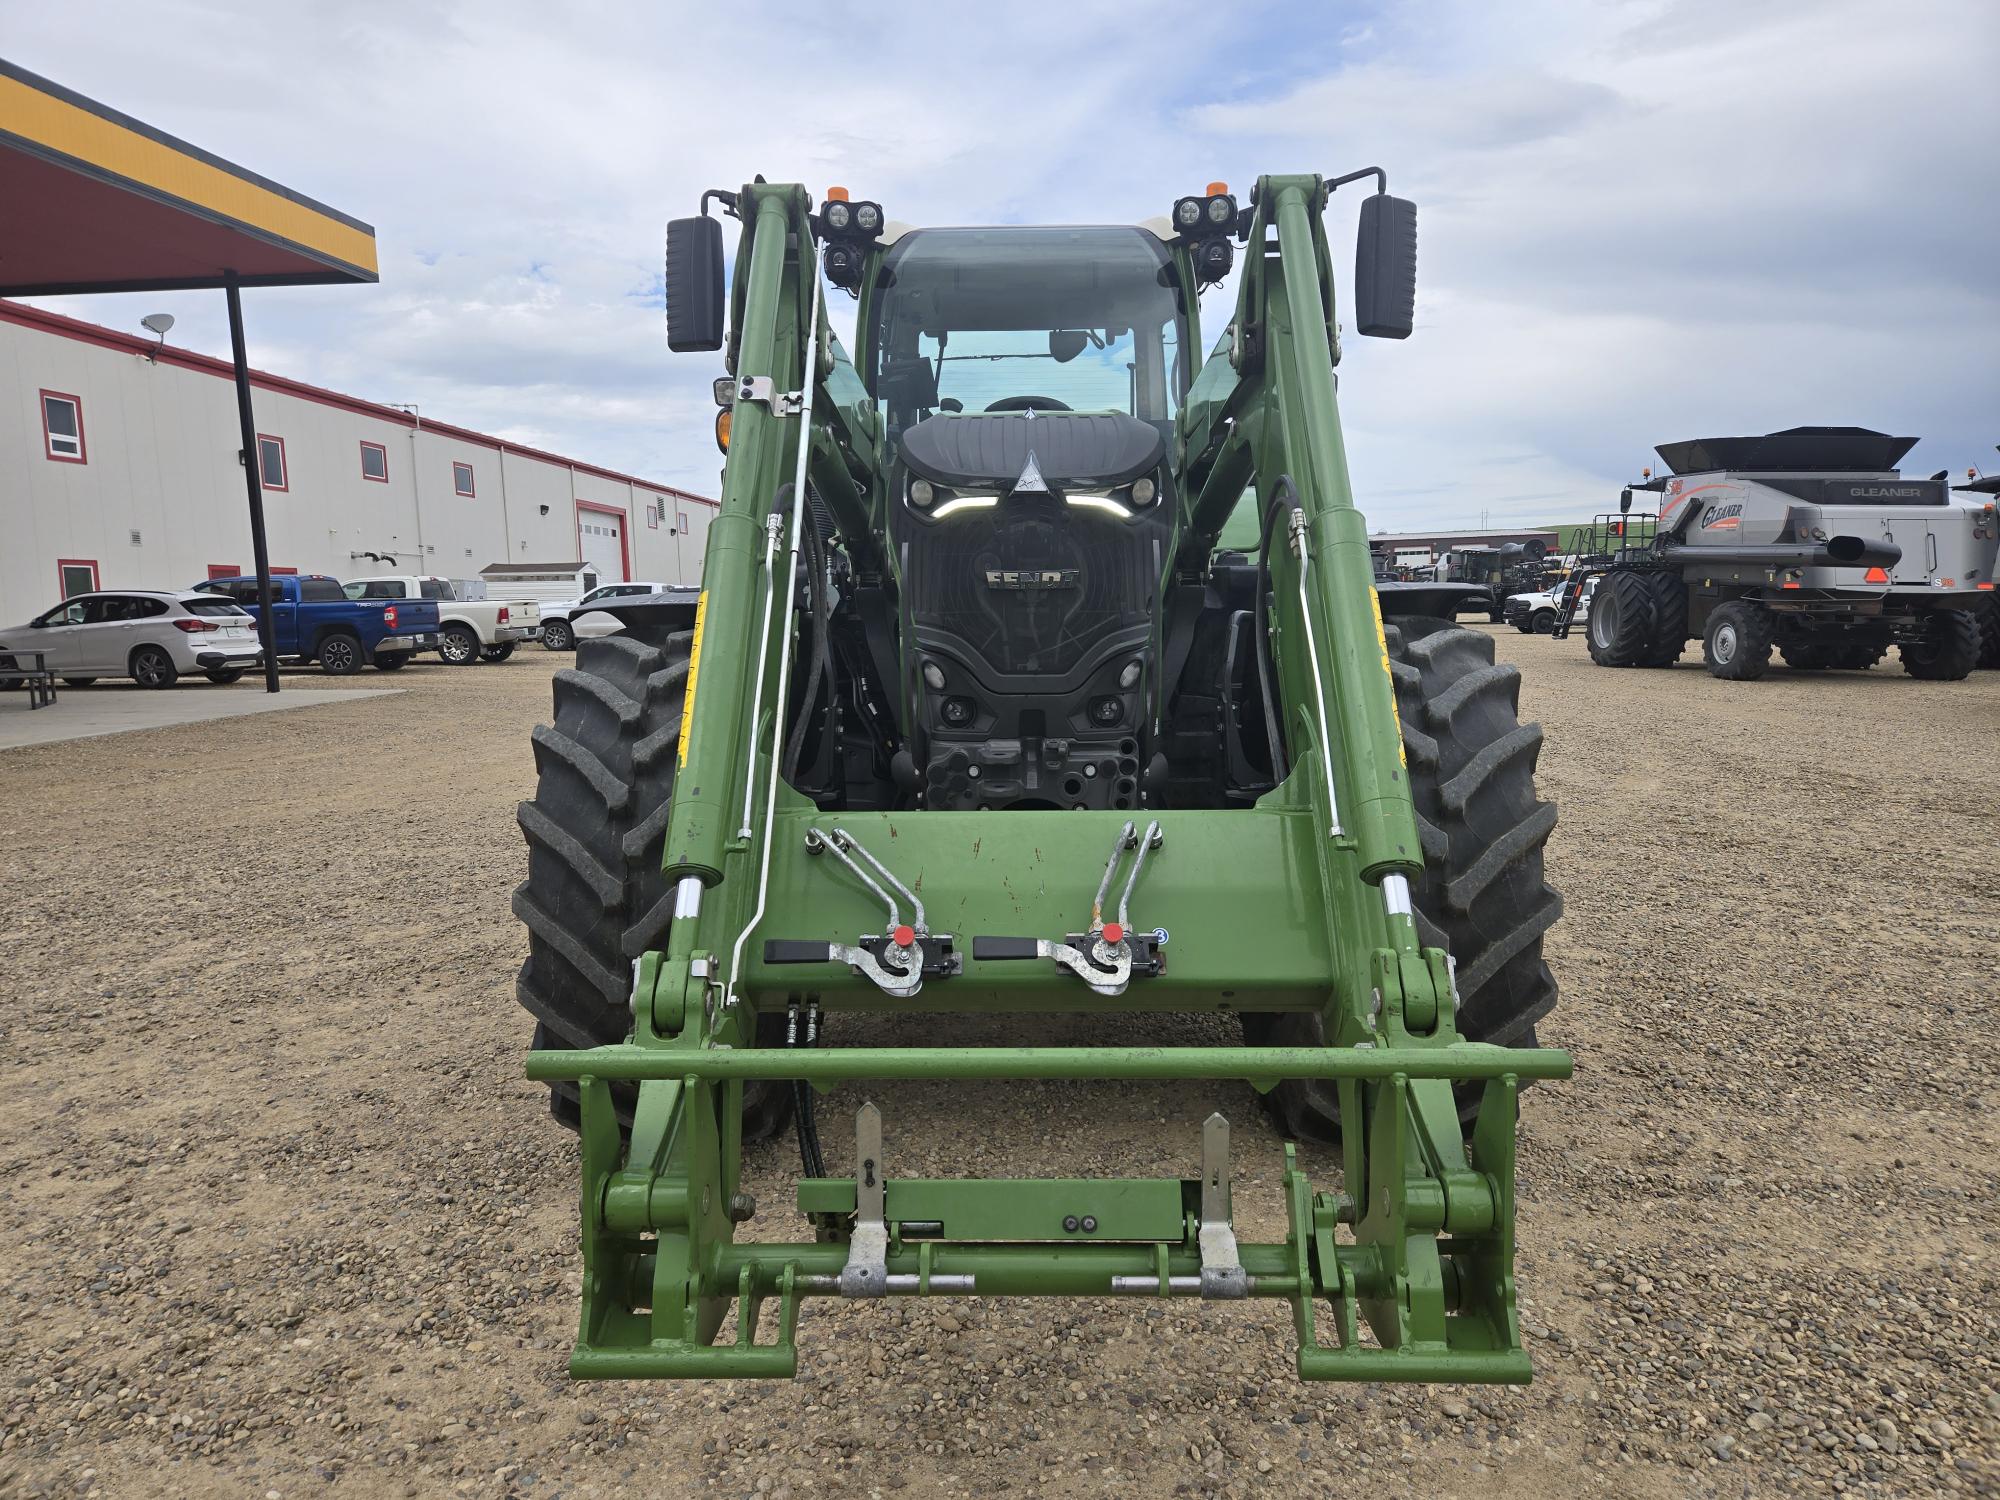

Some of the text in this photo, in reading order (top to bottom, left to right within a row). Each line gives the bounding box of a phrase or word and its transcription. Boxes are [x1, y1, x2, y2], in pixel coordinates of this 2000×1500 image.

[1850, 488, 1921, 497] GLEANER
[1702, 504, 1742, 529] GLEANER
[985, 570, 1079, 589] FENDT
